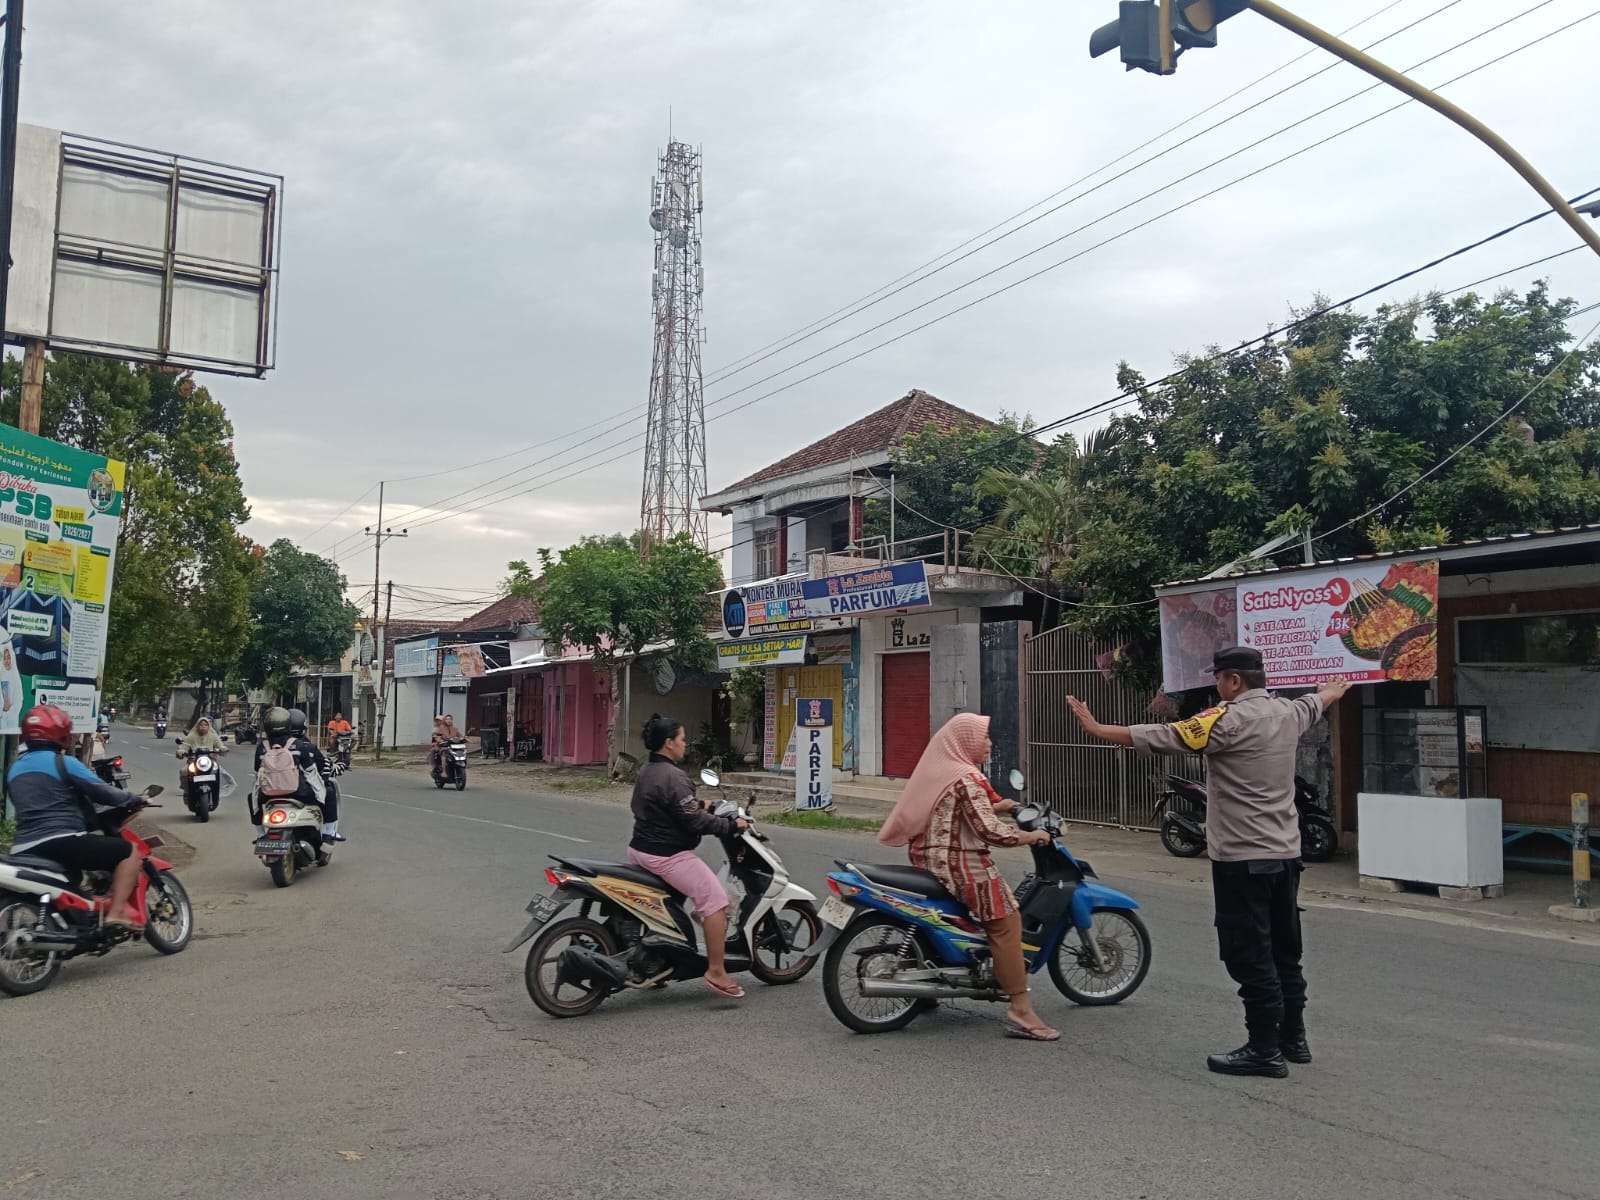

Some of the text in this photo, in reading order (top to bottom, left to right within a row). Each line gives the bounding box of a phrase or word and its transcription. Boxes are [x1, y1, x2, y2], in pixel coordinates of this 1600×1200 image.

[0, 488, 52, 520] PSB
[26, 575, 34, 588] 2
[777, 582, 802, 599] MURA
[829, 589, 898, 613] PARFUM
[1243, 587, 1332, 612] SateNyoss
[1254, 617, 1306, 632] SATE AYAM
[1330, 617, 1350, 630] 13K
[907, 633, 931, 646] La Za
[1254, 630, 1320, 646] SATE TAICHAN
[720, 645, 740, 656] GRATIS
[741, 642, 762, 654] PULSA
[763, 640, 785, 652] SETIAP
[1262, 645, 1312, 659] ATE JAMUR
[1264, 657, 1344, 673] NEKA MINUMAN
[1269, 677, 1296, 685] PESANAN
[1308, 675, 1316, 683] HP
[808, 729, 822, 808] PARFUM
